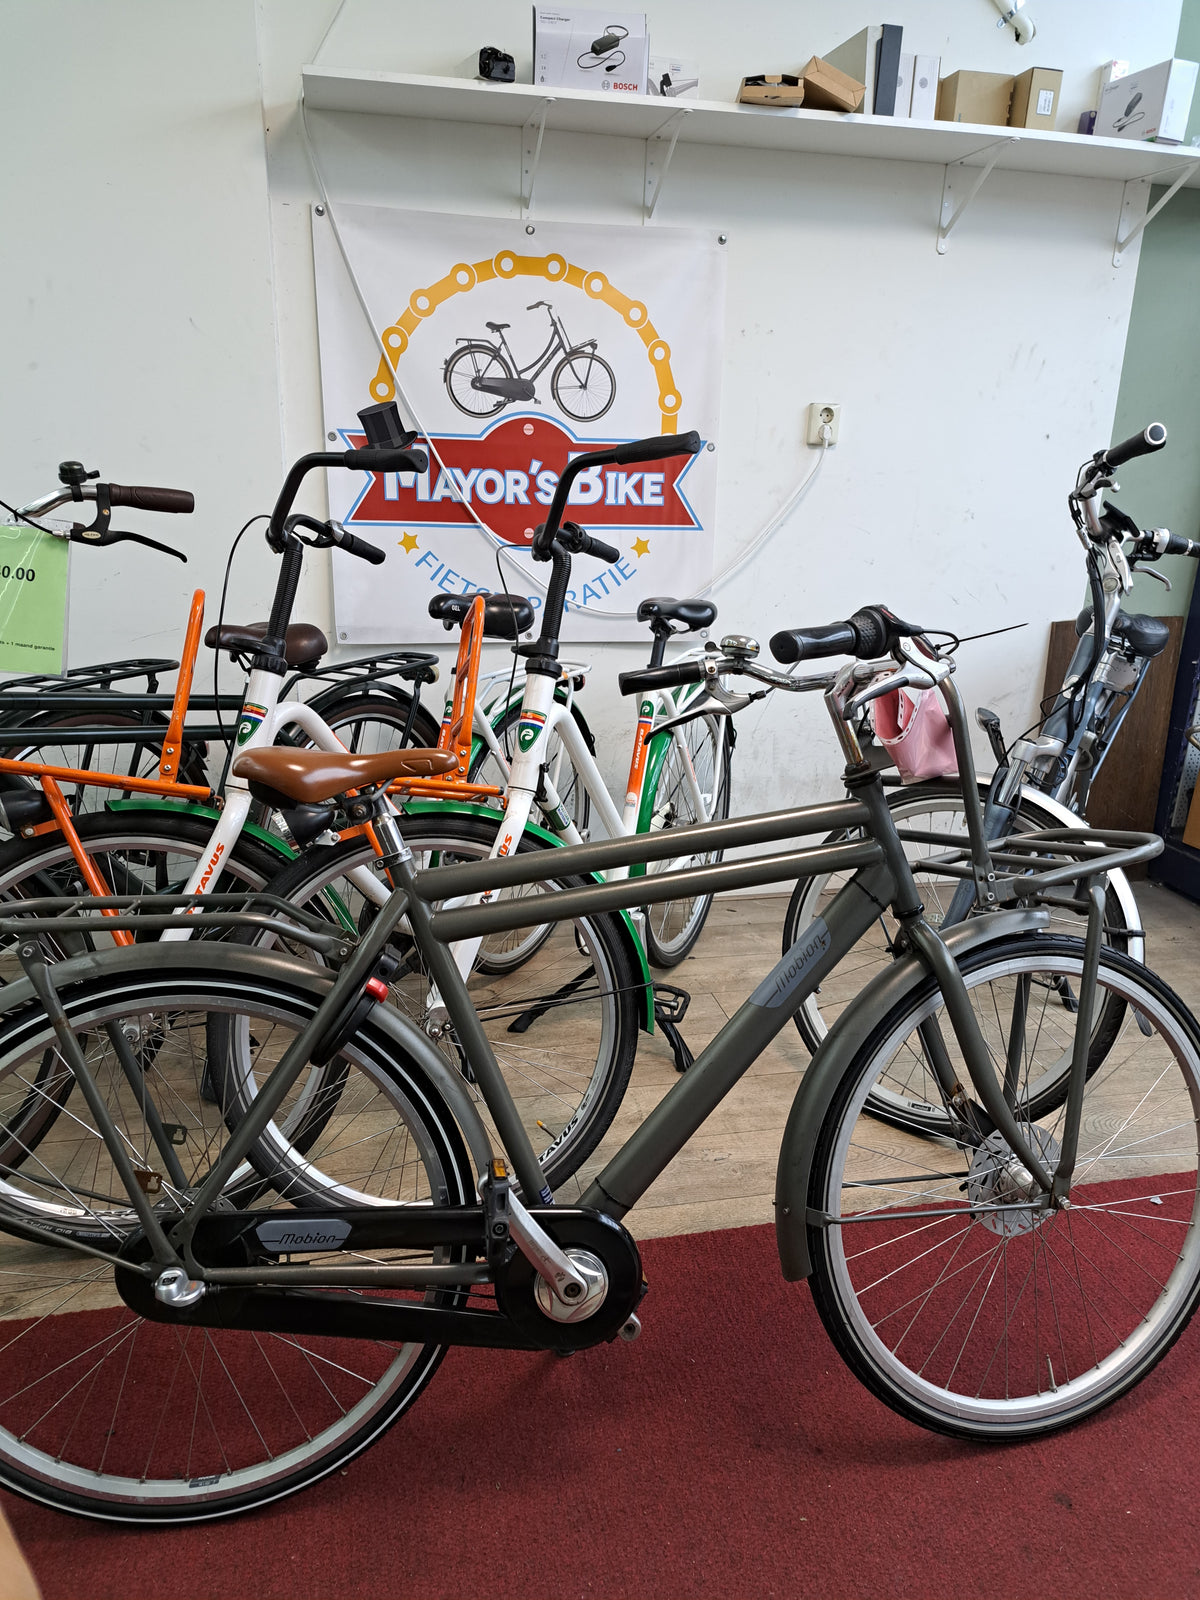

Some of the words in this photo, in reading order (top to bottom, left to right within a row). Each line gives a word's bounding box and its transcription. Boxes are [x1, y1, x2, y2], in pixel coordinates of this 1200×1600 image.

[613, 82, 638, 91] BOSCH
[567, 452, 665, 506] BIKE
[0, 565, 35, 581] 0.00
[634, 728, 645, 770] BATAVUS
[539, 1115, 578, 1162] TAVUS
[279, 1233, 336, 1245] Mobion
